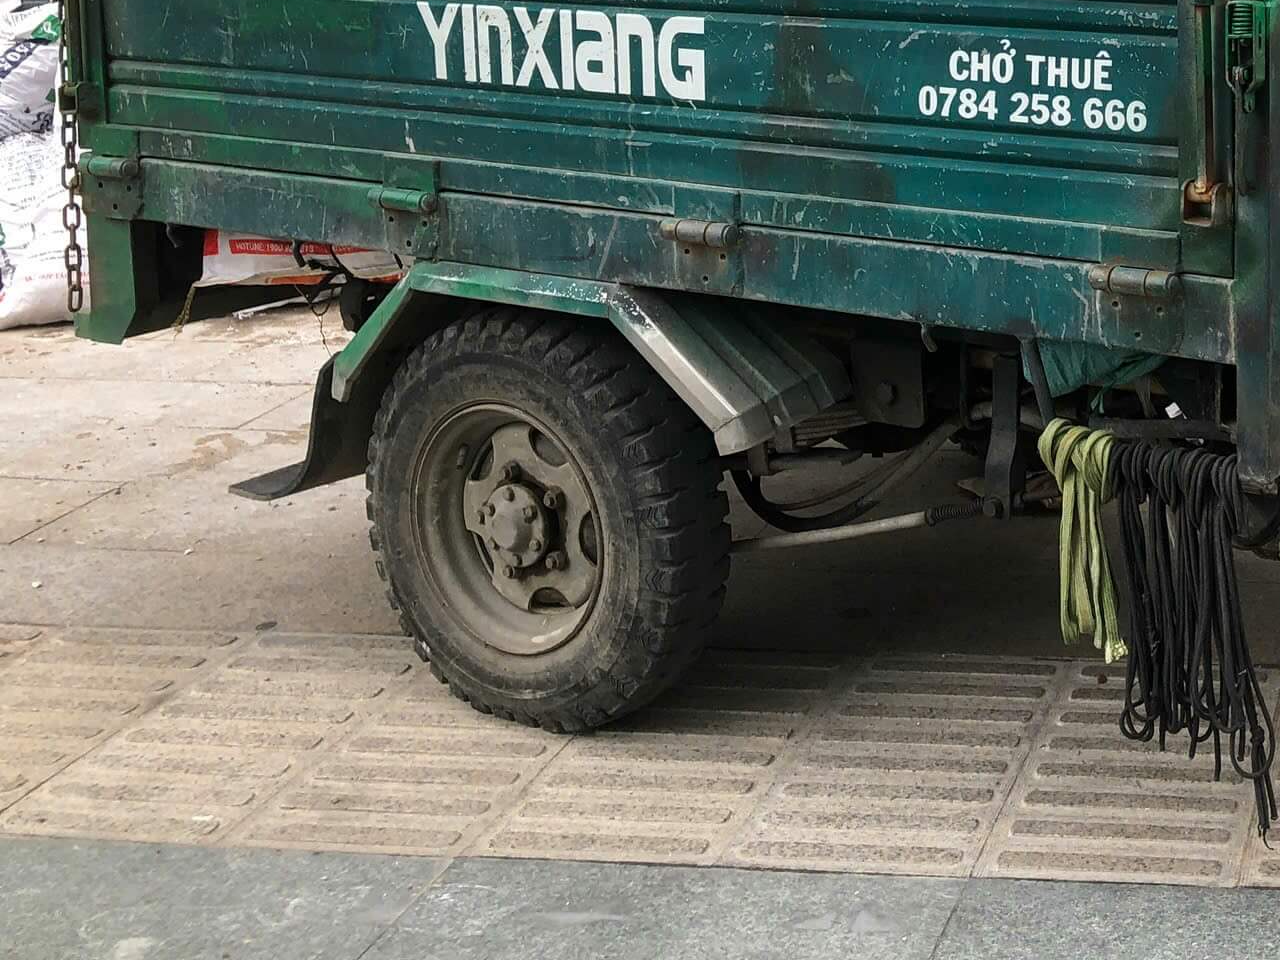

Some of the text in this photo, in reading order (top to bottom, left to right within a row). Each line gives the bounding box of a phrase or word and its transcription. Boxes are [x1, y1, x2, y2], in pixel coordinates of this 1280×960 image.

[416, 1, 705, 101] YINXIANG
[949, 38, 1113, 92] CHỞ THUÊ
[918, 88, 1148, 133] 0784 258 666
